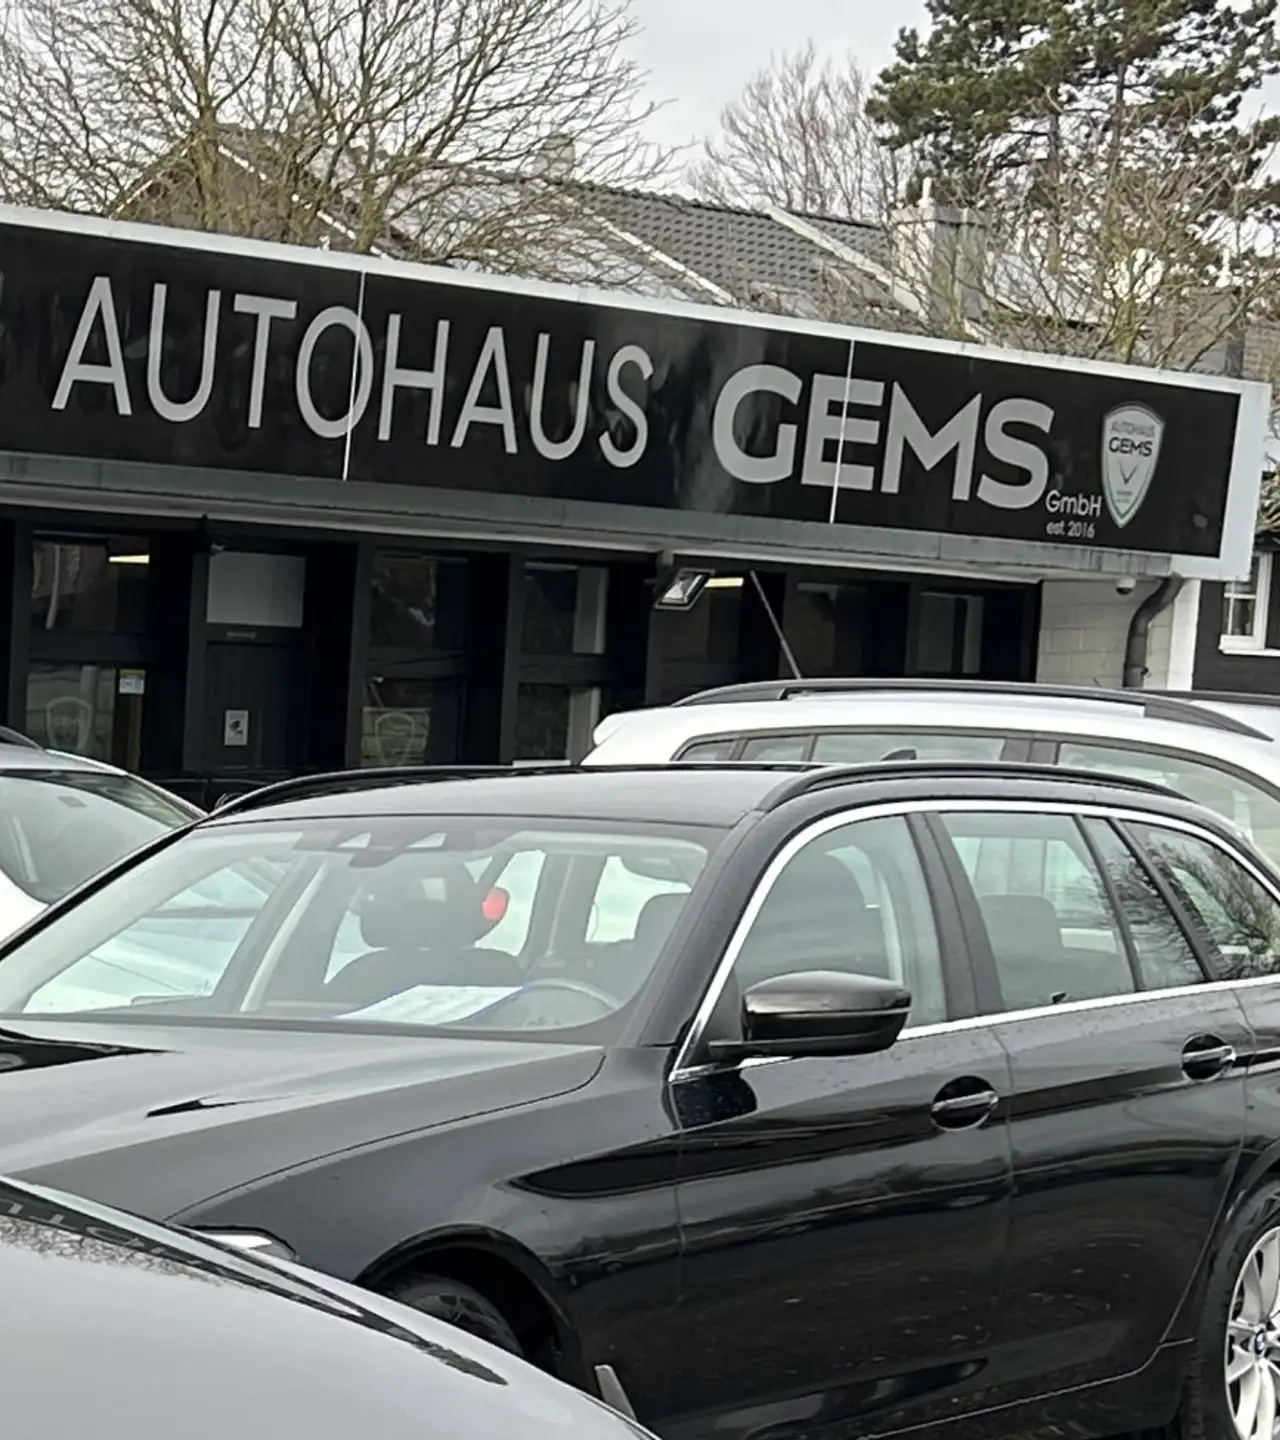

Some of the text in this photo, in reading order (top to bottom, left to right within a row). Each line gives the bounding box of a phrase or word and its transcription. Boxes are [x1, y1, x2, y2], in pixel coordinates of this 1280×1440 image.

[51, 276, 1055, 509] AUTOHAUS GEMS
[1108, 437, 1153, 457] GEMS
[1045, 489, 1102, 517] GmbH
[1068, 520, 1095, 538] 2016
